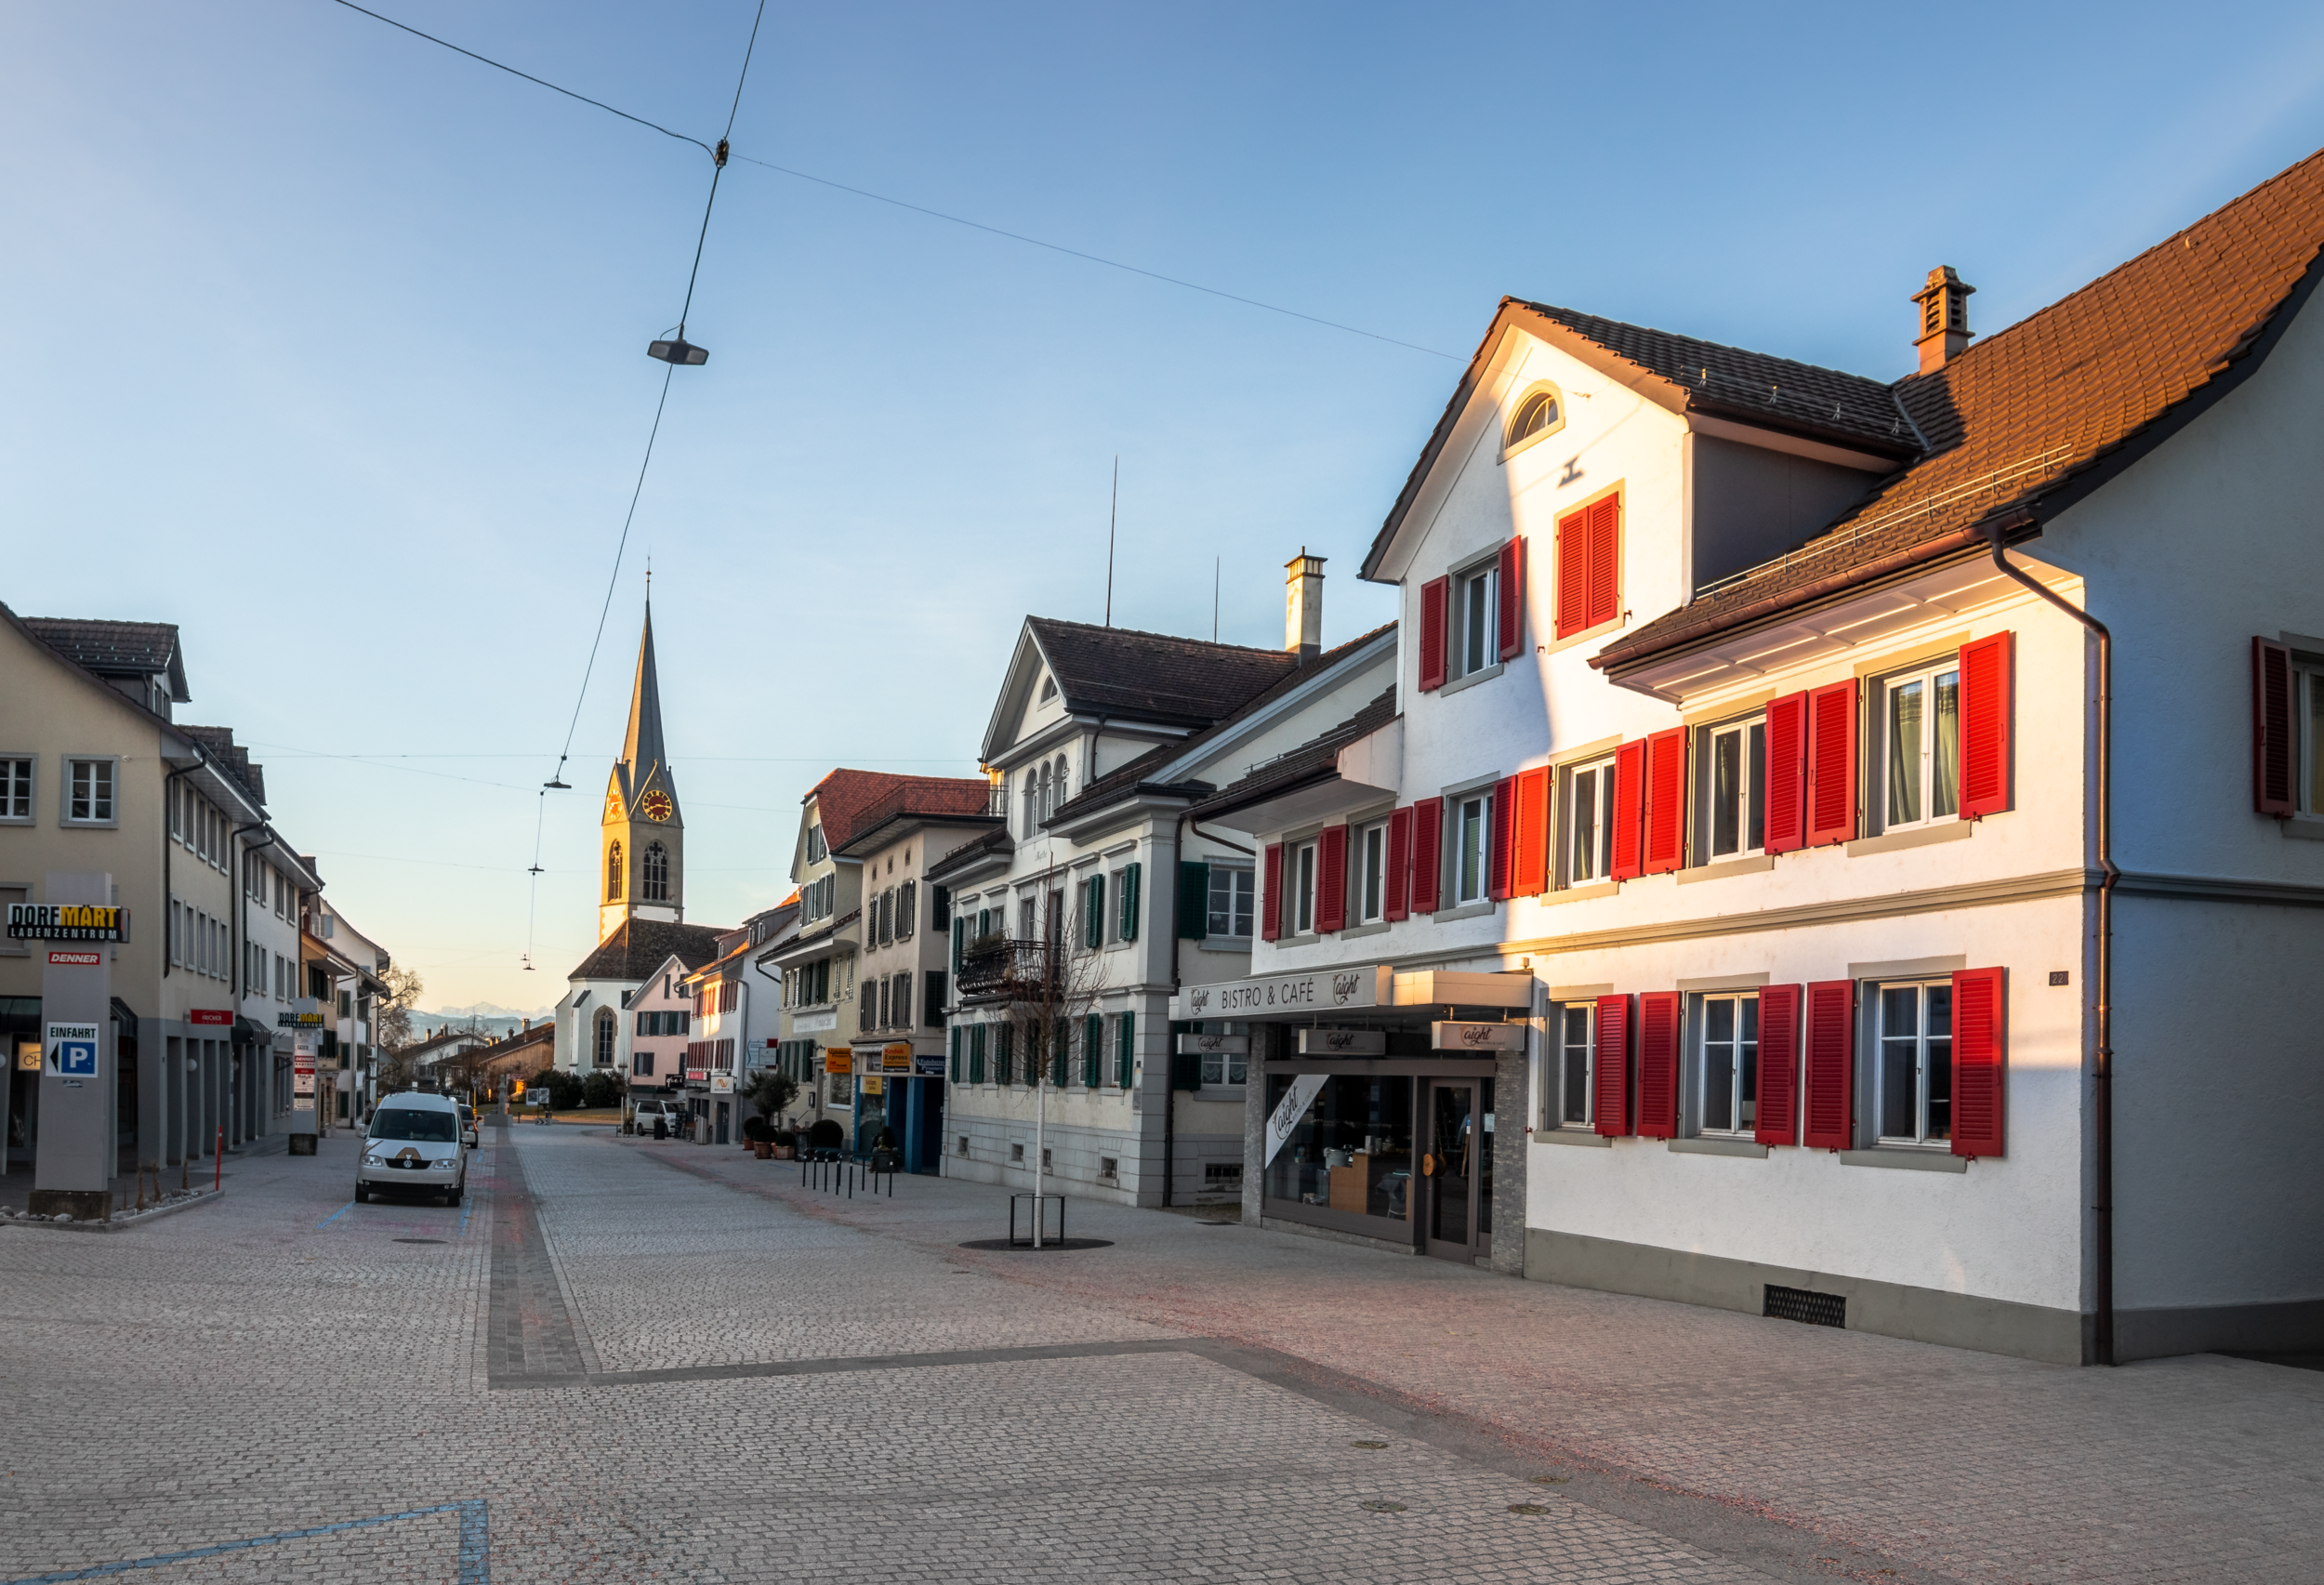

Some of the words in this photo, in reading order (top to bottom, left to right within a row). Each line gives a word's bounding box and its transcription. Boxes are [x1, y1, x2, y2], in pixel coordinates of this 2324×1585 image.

[11, 927, 117, 939] LADENZENTRUM
[50, 954, 98, 963] DENNER
[2053, 973, 2064, 984] 22
[1221, 986, 1261, 1009] BISTRO
[1267, 985, 1275, 1005] &
[1281, 977, 1314, 1004] CAFÉ
[50, 1026, 96, 1038] EINFAHRT
[70, 1047, 88, 1068] P
